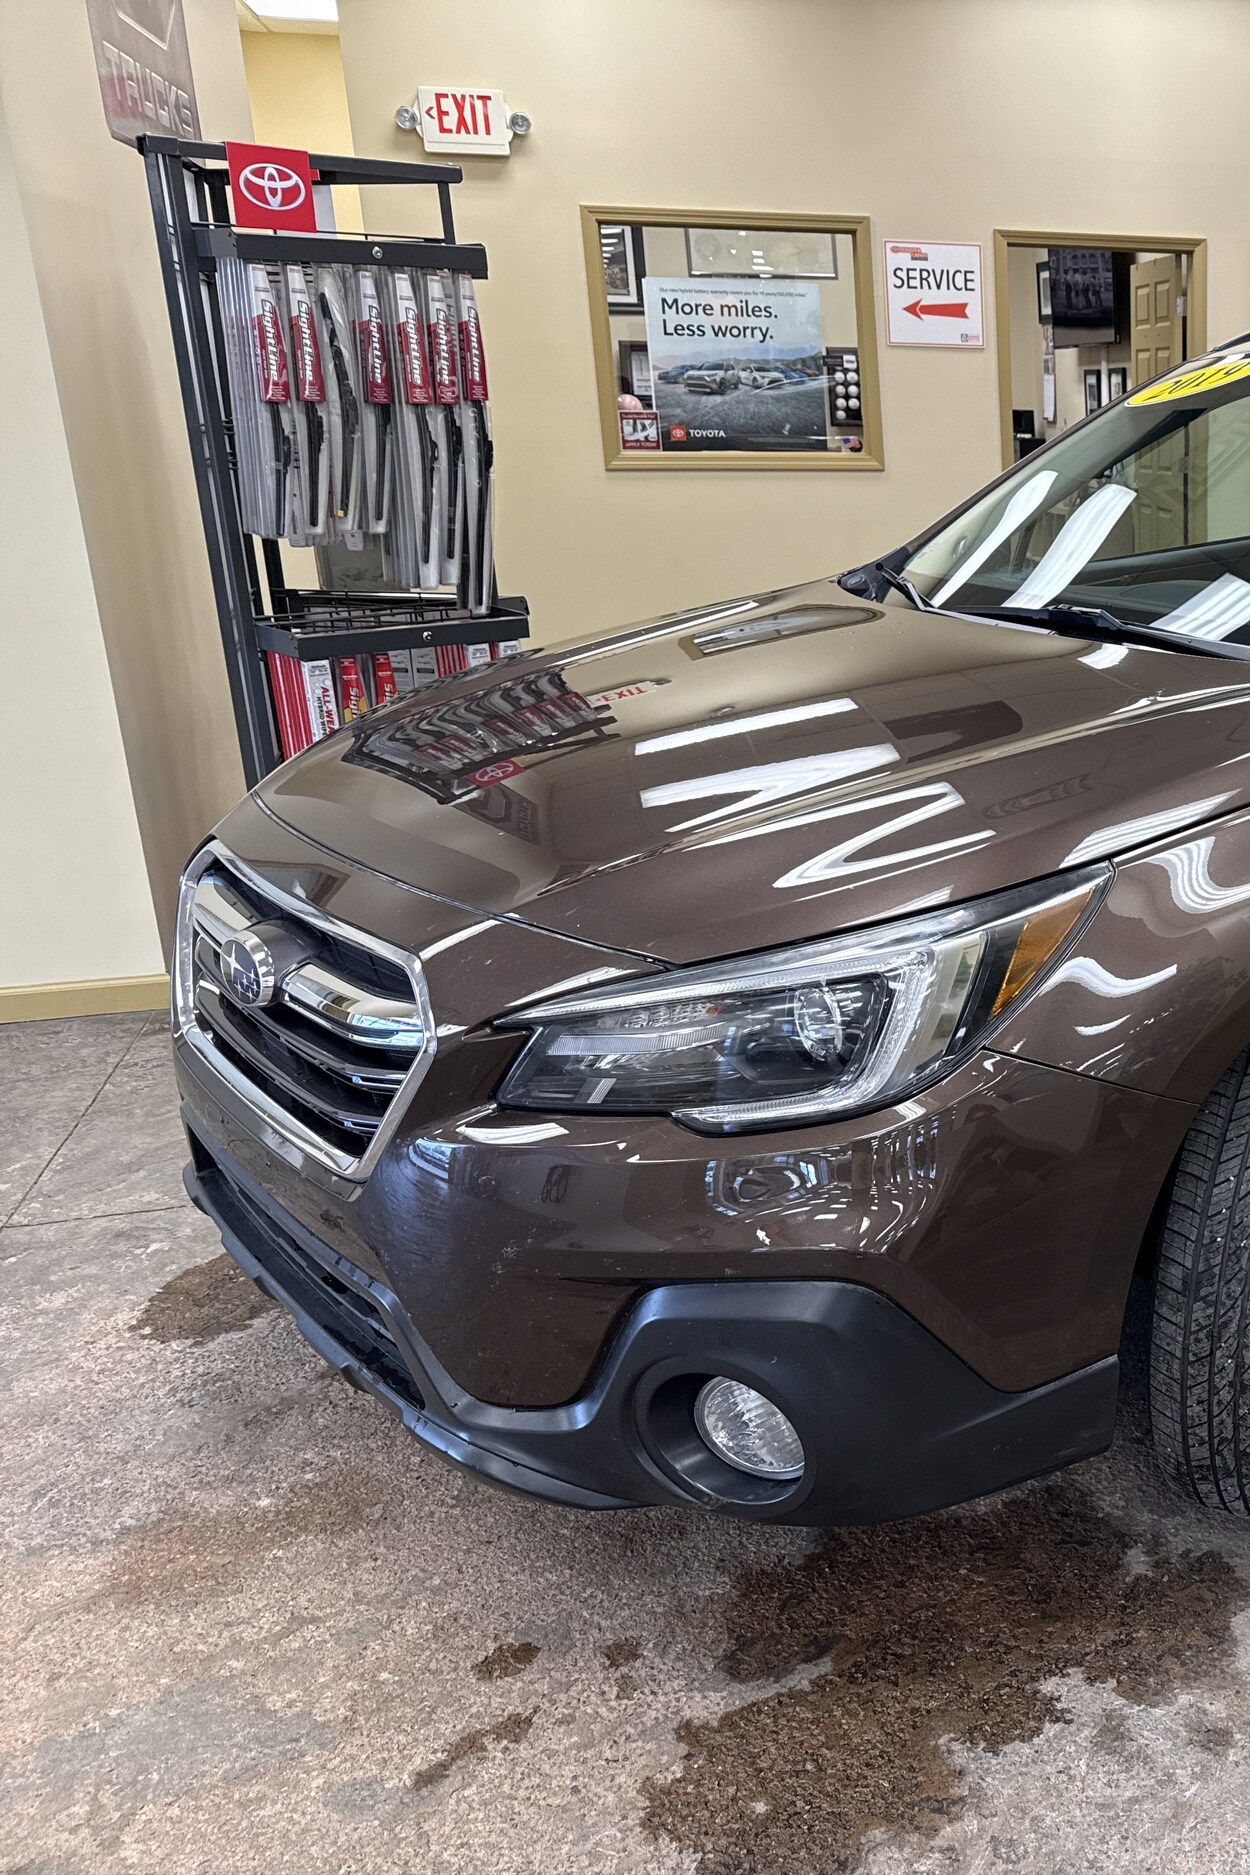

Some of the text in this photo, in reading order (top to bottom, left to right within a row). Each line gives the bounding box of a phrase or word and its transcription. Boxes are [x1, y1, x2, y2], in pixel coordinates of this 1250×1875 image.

[102, 40, 196, 140] TRUCKS
[434, 92, 492, 136] EXIT
[661, 297, 779, 319] More miles.
[893, 266, 976, 291] SERVICE
[261, 300, 278, 381] SightLine
[298, 300, 313, 381] SightLine
[369, 305, 382, 383] SightLine
[405, 307, 421, 384] SightLine
[436, 308, 449, 384] SightLine
[468, 307, 480, 381] SightLine
[662, 319, 774, 343] Less worry.
[689, 429, 726, 438] TOYOTA
[321, 685, 337, 734] ALL-WEA
